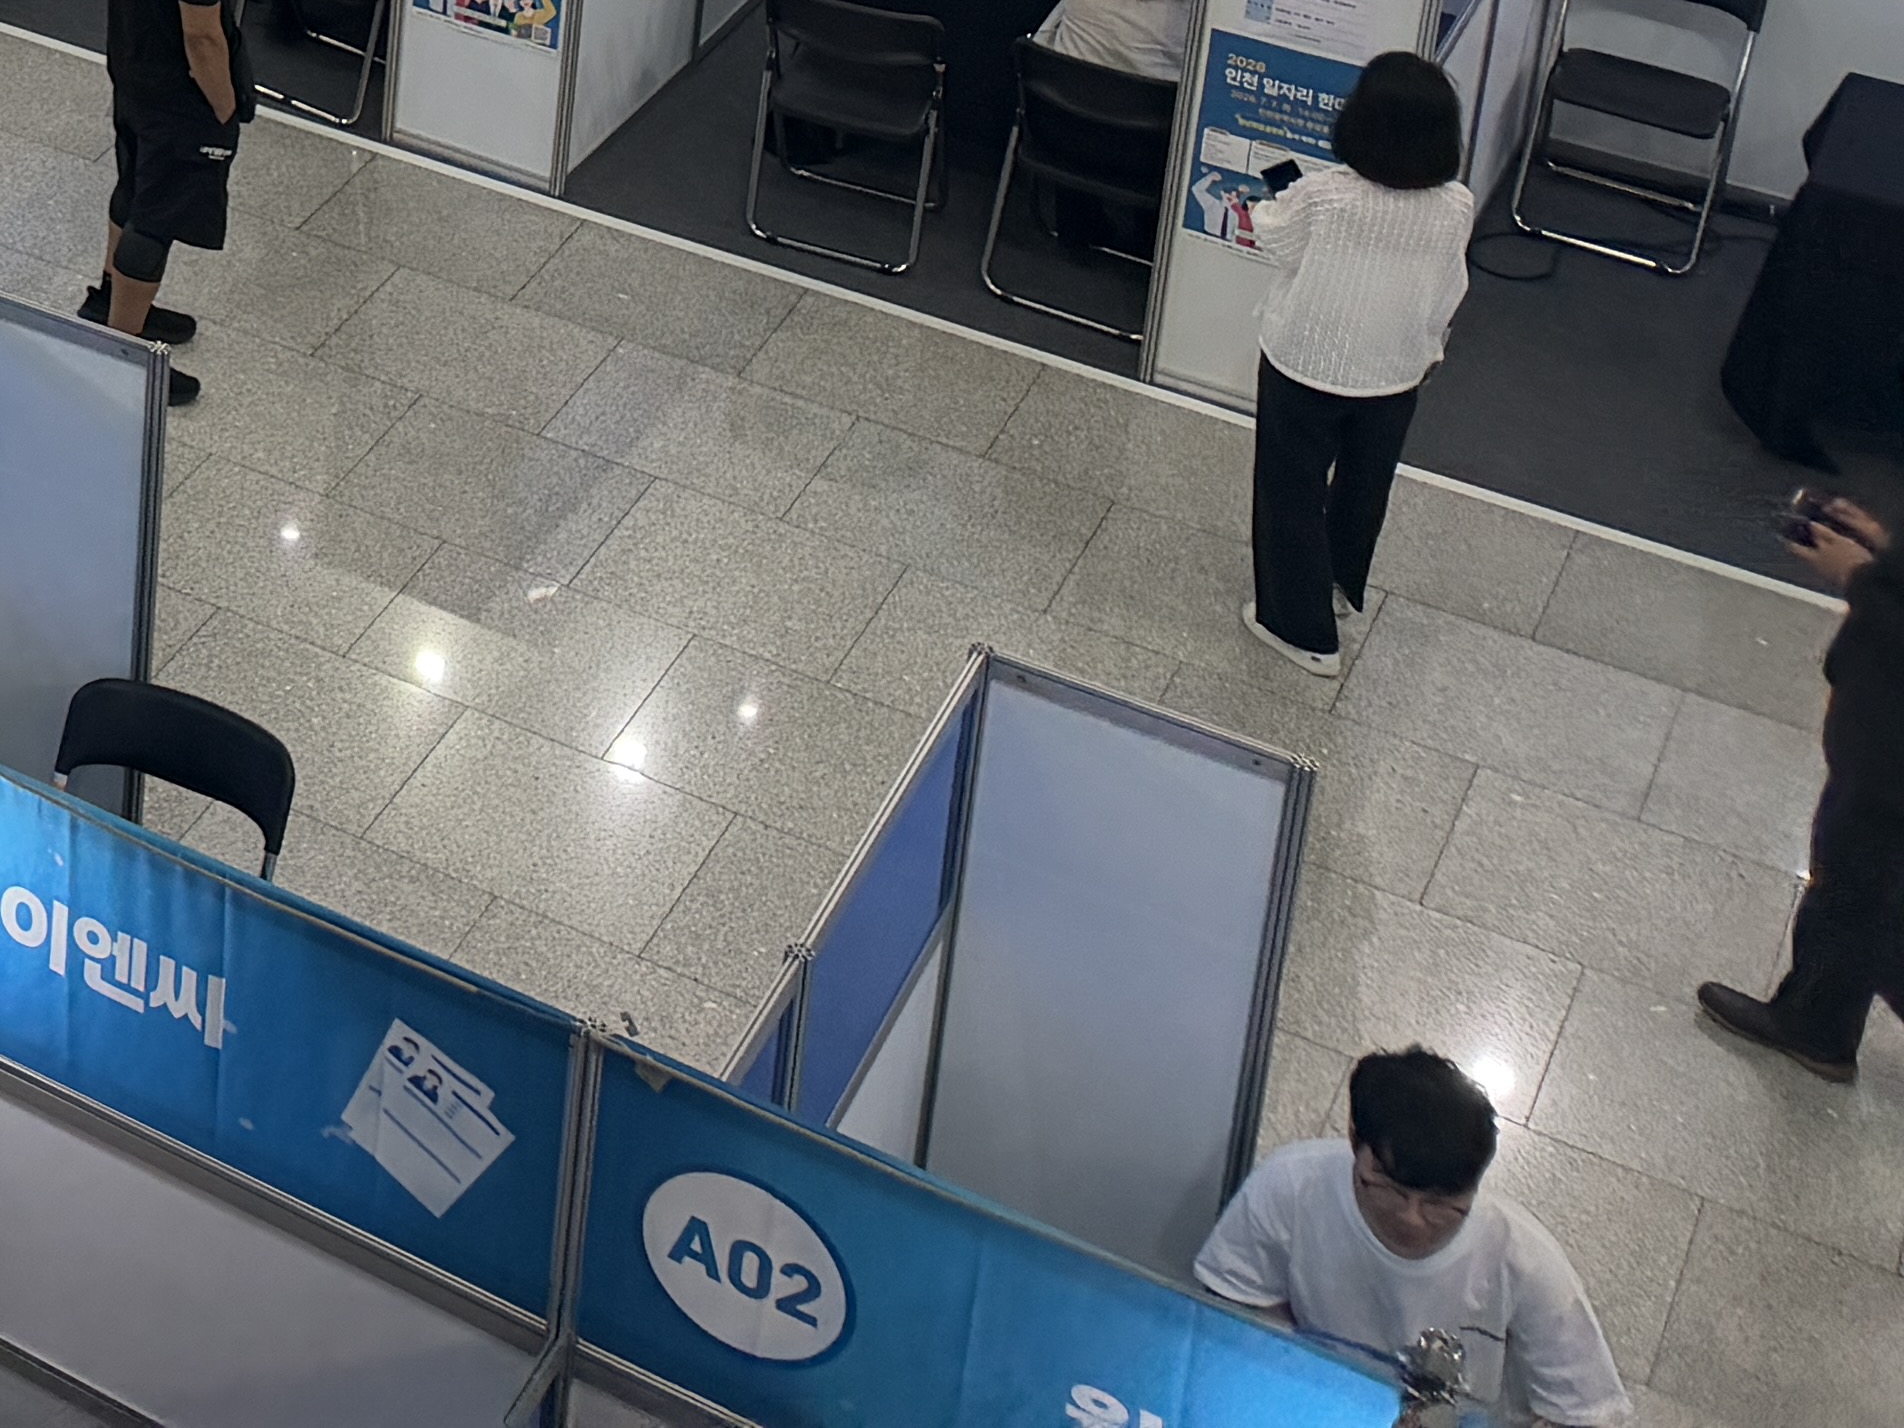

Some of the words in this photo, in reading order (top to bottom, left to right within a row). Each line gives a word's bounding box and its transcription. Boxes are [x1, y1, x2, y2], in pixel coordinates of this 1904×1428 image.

[1225, 67, 1259, 91] 인천
[1263, 77, 1313, 106] 일자리
[666, 1215, 820, 1327] A02
